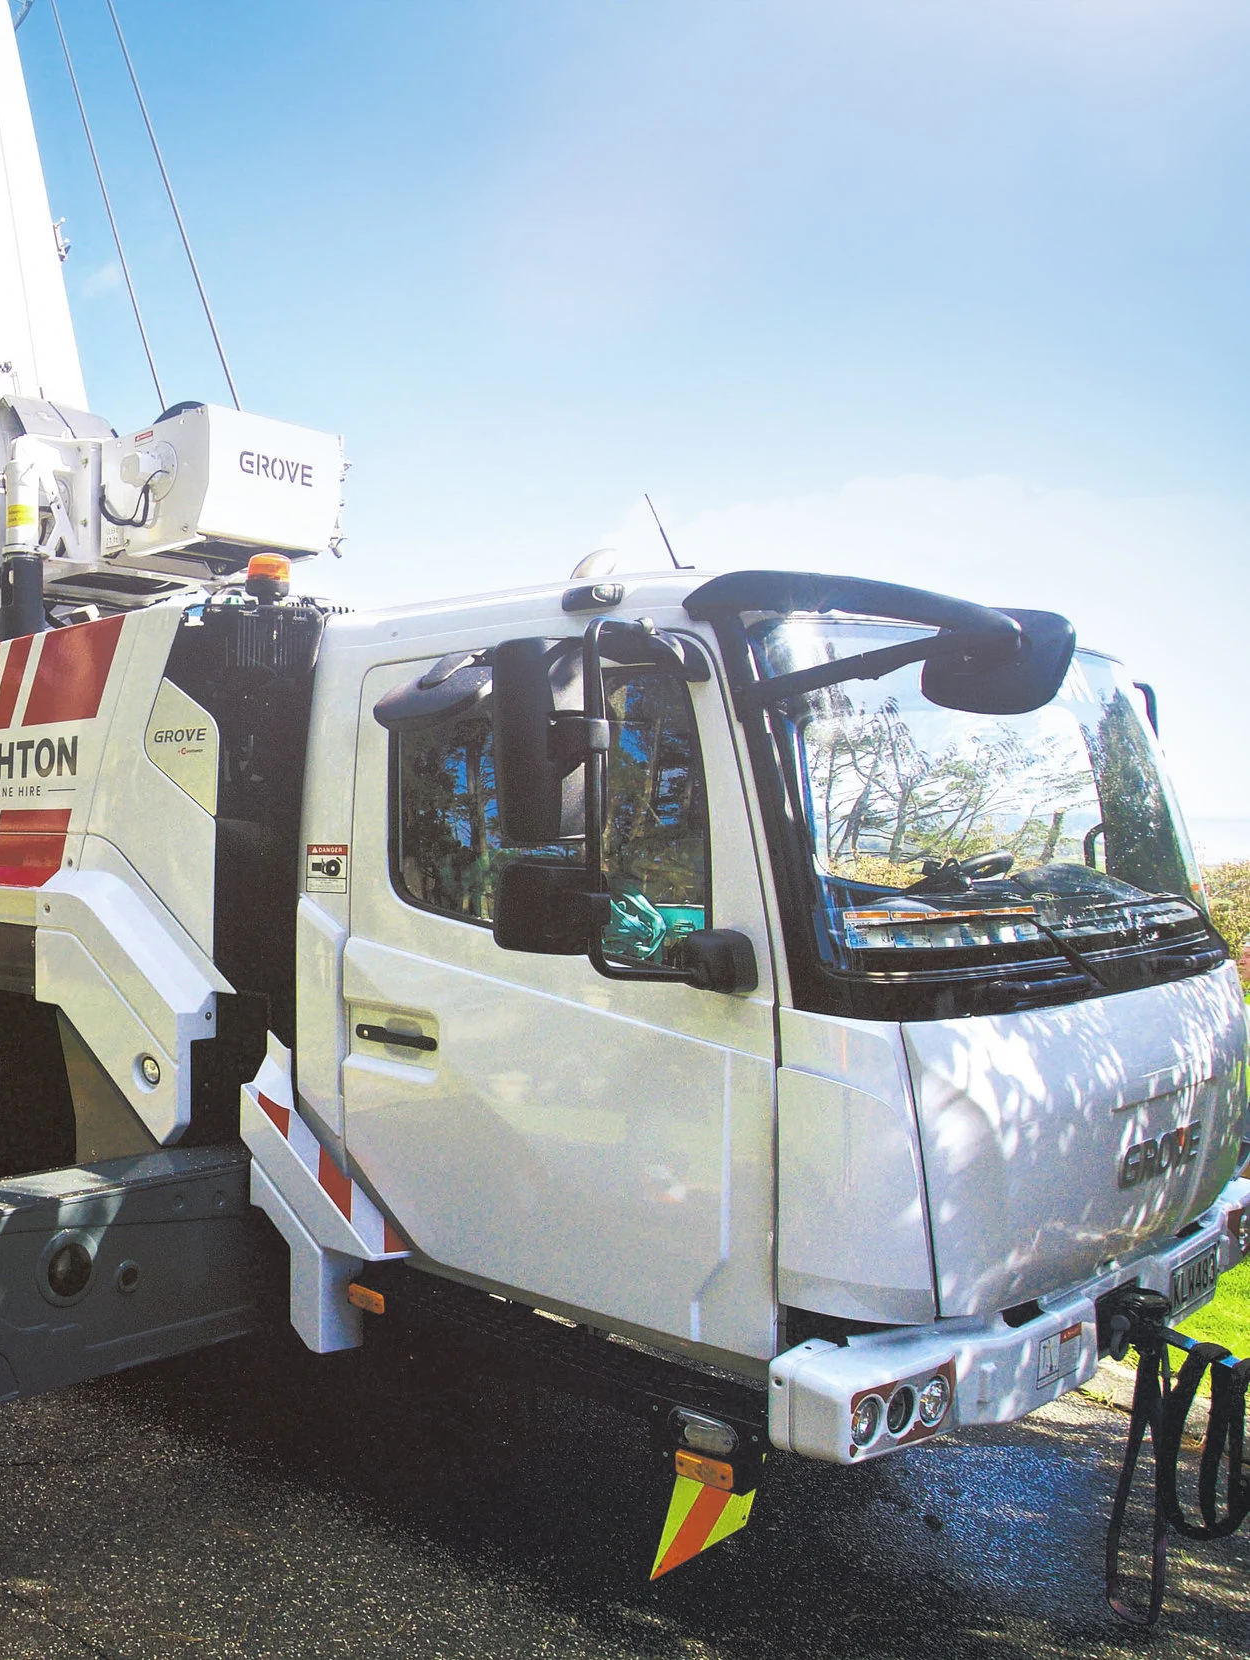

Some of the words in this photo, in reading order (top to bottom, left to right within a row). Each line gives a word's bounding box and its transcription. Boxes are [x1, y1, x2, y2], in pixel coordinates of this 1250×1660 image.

[239, 450, 313, 487] GROVE
[154, 727, 207, 743] GROVE
[18, 785, 41, 797] HIRE
[1117, 1120, 1201, 1189] GROVE
